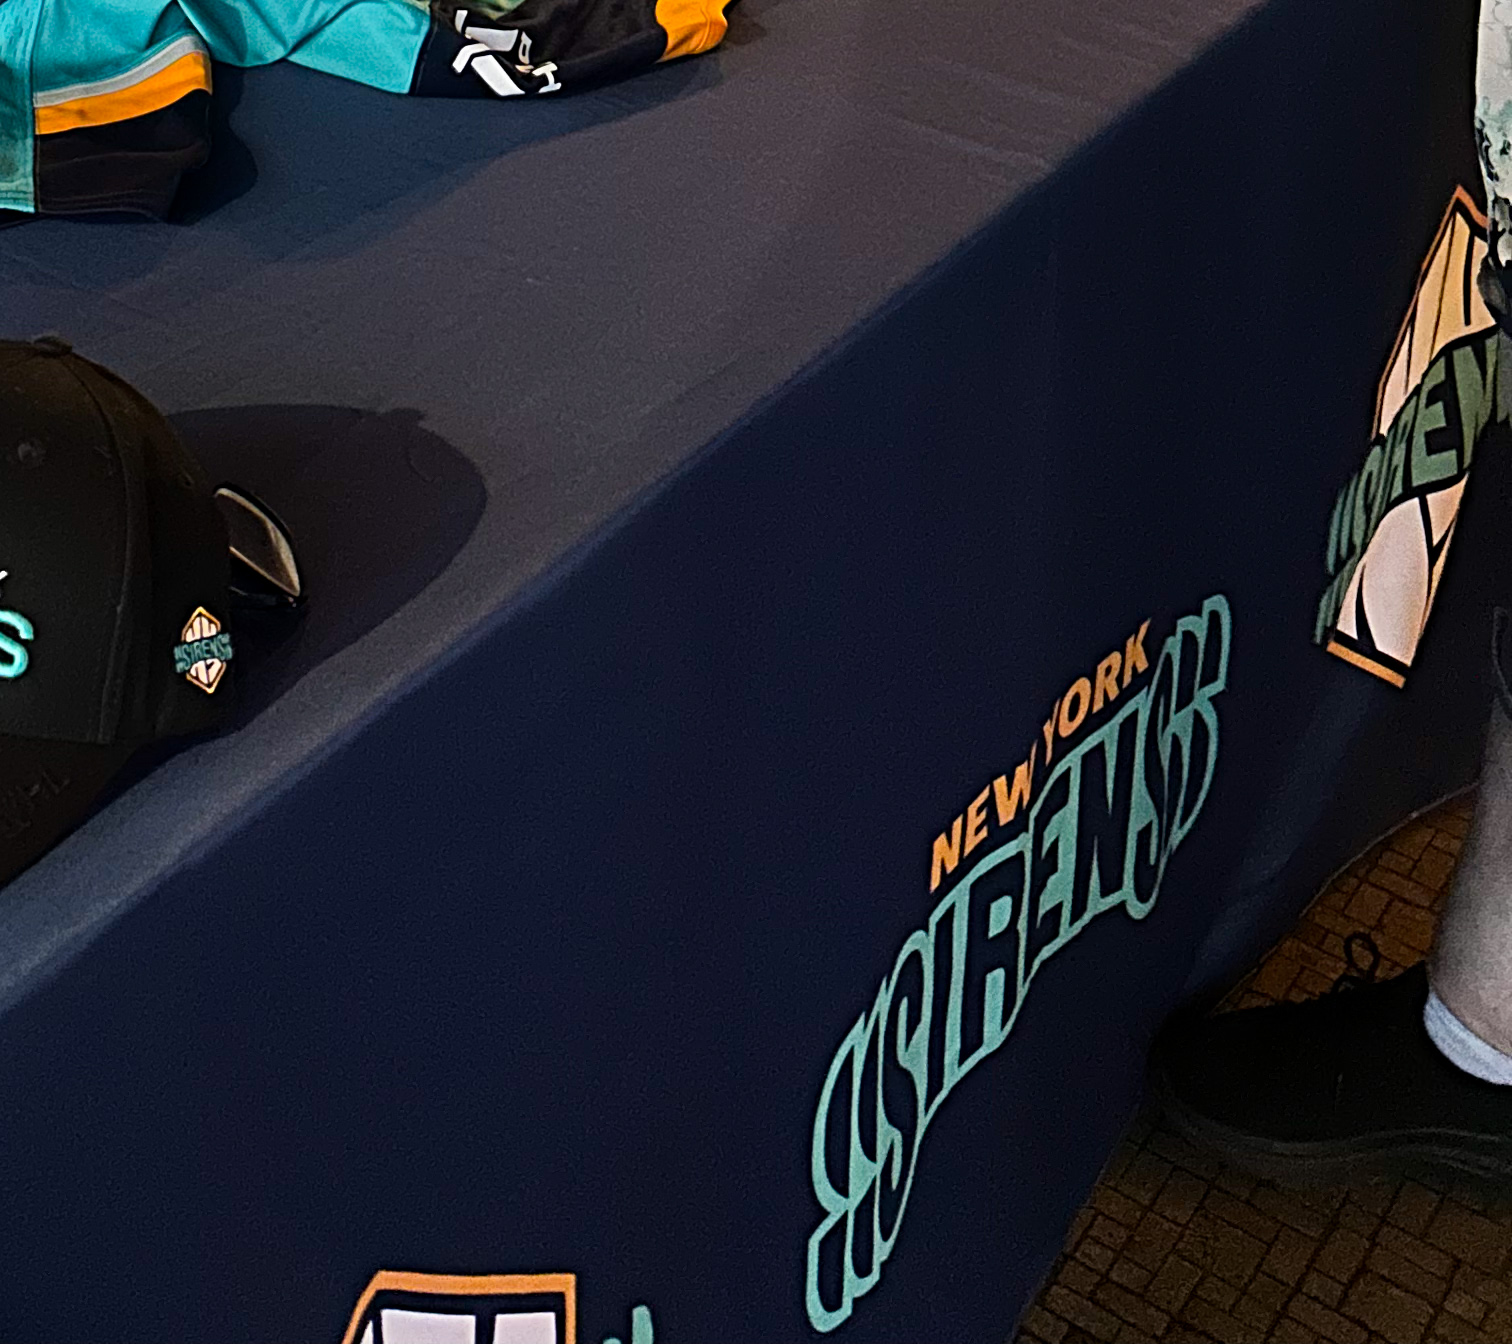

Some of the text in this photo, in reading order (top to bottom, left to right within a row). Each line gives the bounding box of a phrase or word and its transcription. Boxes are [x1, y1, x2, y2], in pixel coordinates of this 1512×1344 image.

[177, 633, 230, 672] SIRENS
[928, 618, 1151, 894] NEW YORK
[808, 596, 1231, 1330] SIRENS
